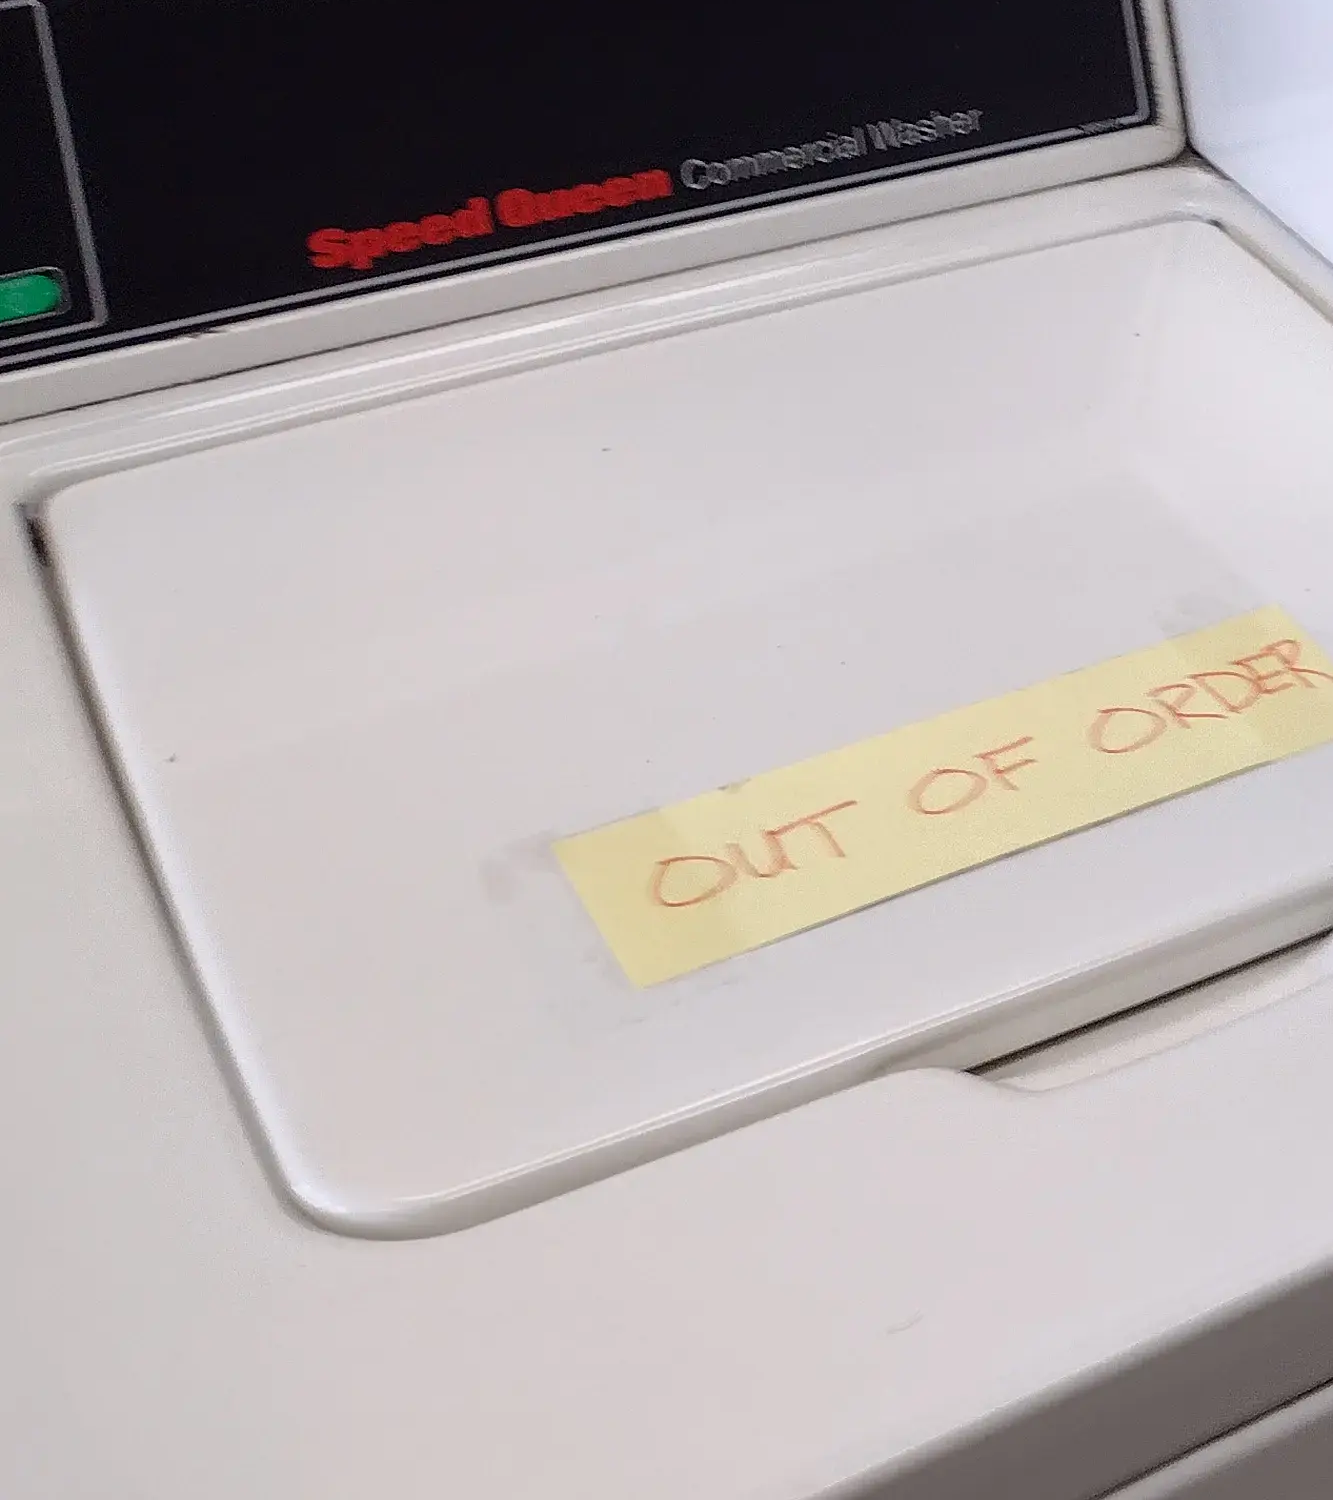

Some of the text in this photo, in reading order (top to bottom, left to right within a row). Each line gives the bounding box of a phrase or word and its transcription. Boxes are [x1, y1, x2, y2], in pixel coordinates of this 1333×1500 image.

[305, 106, 984, 272] Speed Queen Commercial Washer
[646, 797, 859, 910] OUT
[907, 735, 1038, 817] OF
